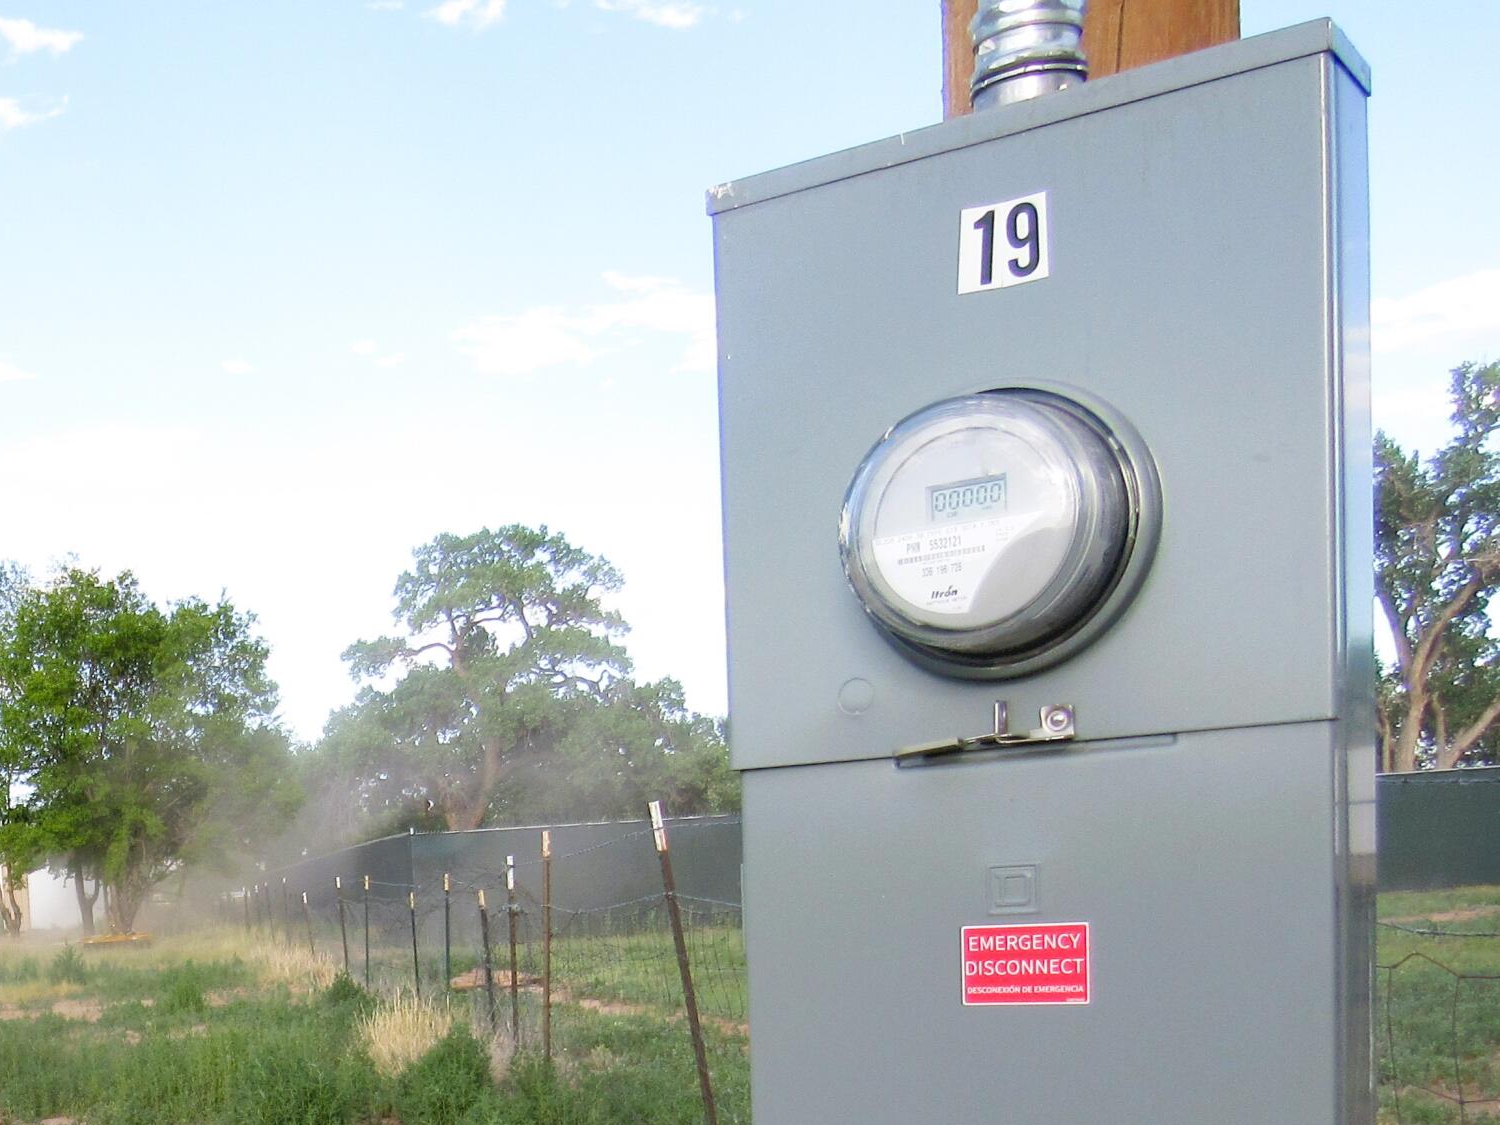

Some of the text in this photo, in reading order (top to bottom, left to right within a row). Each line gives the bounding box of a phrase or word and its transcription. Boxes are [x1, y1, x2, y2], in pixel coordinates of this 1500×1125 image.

[972, 202, 1041, 285] 19
[934, 483, 1002, 513] 00000
[968, 933, 1081, 952] EMERGENCY
[965, 958, 1085, 976] DISCONNECT
[967, 984, 1084, 994] DESCONEXIÓN DE EMERGENCIA
